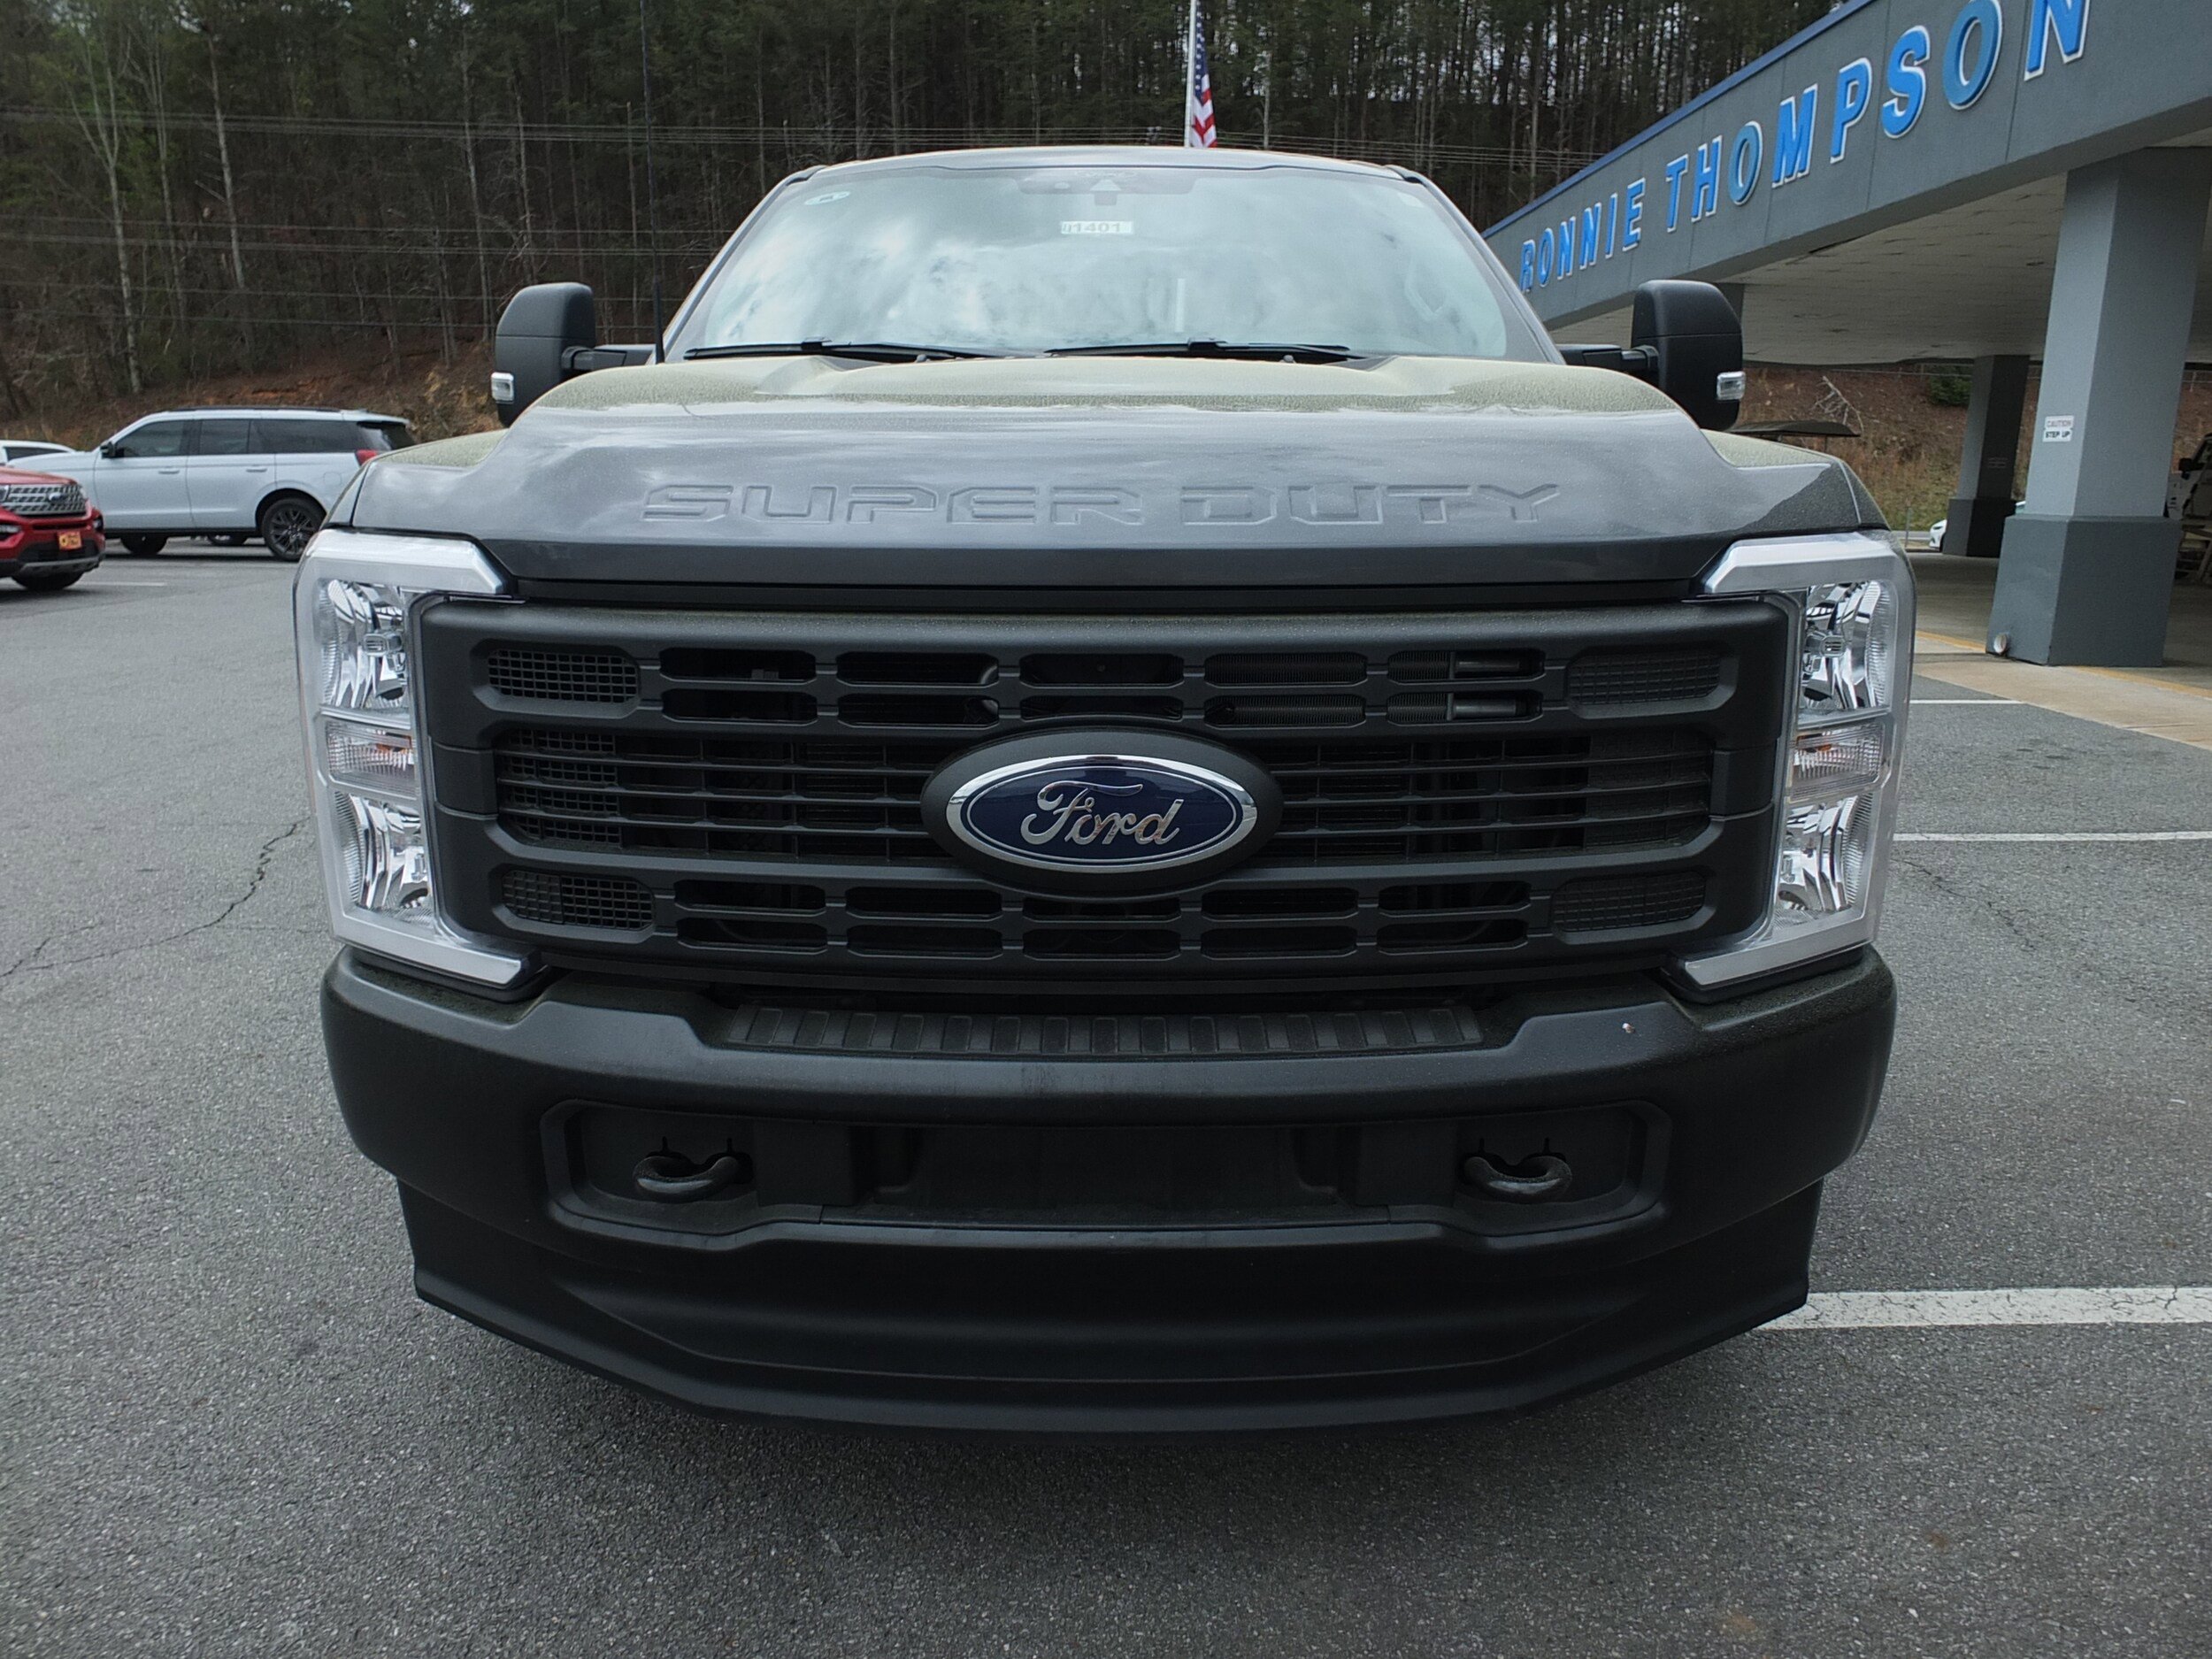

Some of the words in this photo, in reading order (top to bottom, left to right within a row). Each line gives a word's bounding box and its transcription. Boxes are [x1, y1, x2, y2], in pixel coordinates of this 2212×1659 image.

[1519, 177, 1646, 293] RONNIE
[1665, 0, 2091, 233] THOMPSON
[2045, 430, 2060, 439] STEP
[2061, 430, 2070, 439] UP
[642, 484, 1144, 526] SUPER
[1181, 483, 1561, 526] DUTY
[1020, 780, 1184, 846] Ford
